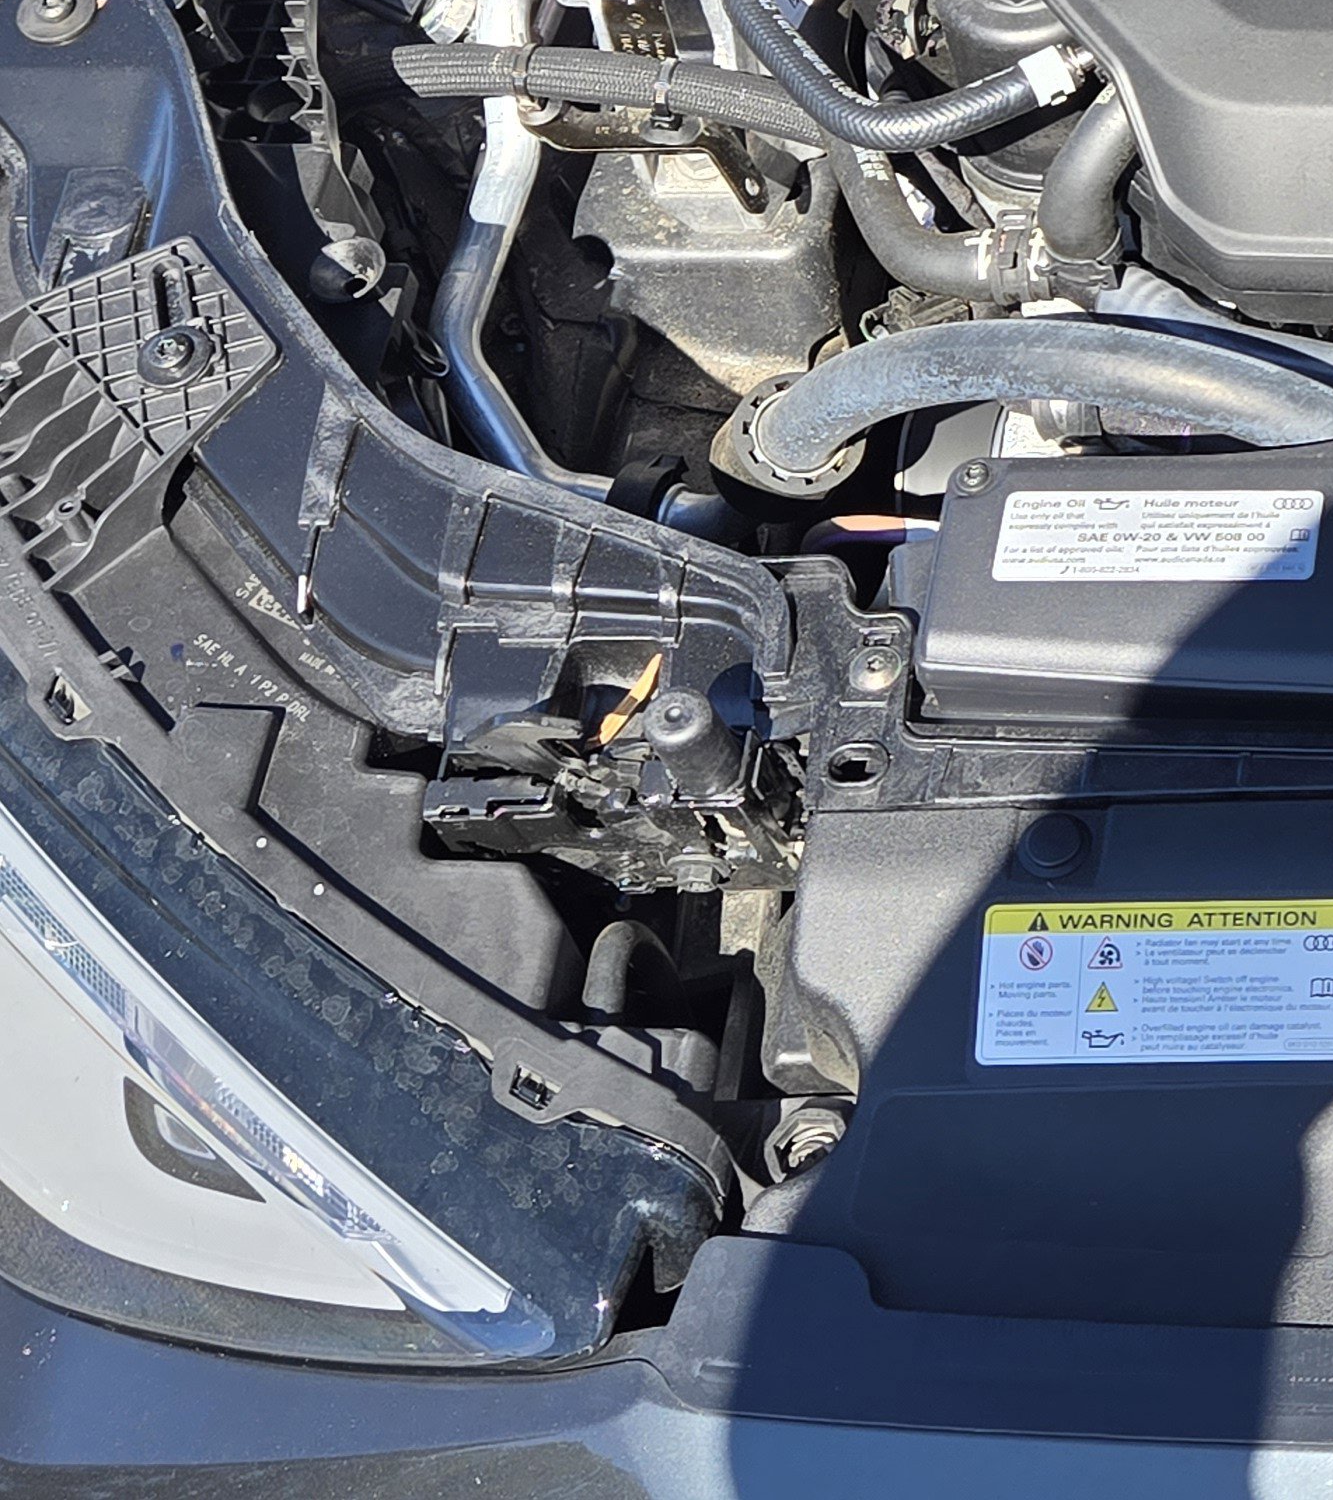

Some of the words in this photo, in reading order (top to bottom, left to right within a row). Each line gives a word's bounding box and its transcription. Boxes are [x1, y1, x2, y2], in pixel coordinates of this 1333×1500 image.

[1013, 499, 1061, 510] Engine
[1067, 499, 1085, 508] Oil
[1143, 499, 1180, 508] Huile
[1184, 500, 1240, 508] moteur
[1077, 533, 1108, 542] SAE
[1112, 533, 1162, 542] 0W-20
[1166, 533, 1178, 541] &
[1183, 533, 1211, 541] VW
[1247, 533, 1265, 541] 00
[193, 634, 221, 656] SAE
[1058, 913, 1174, 931] WARNING
[1186, 911, 1317, 929] ATTENTION
[1016, 982, 1046, 992] engine
[998, 991, 1031, 999] Moving
